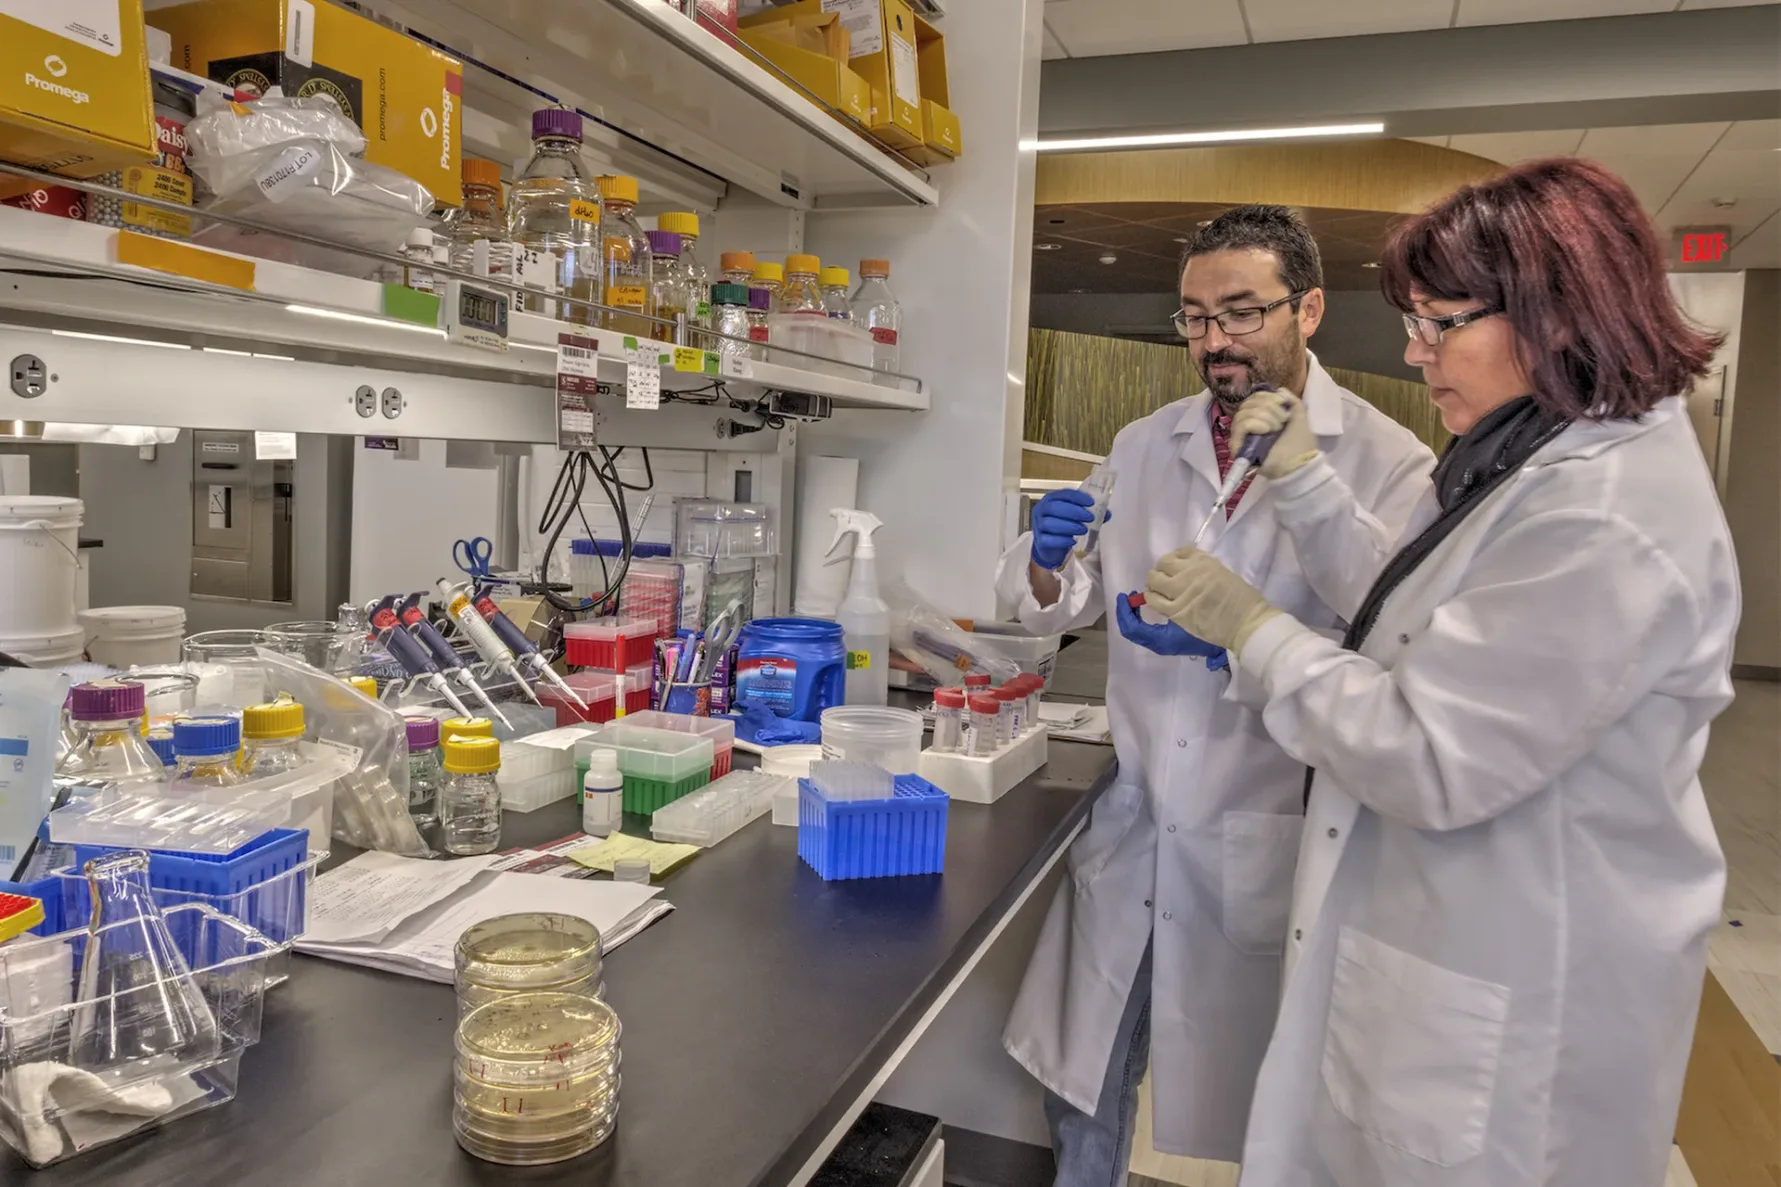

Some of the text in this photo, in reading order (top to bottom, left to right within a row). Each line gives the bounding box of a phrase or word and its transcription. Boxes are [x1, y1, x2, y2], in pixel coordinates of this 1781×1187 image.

[25, 72, 90, 104] Promega
[379, 67, 388, 141] promega.com
[440, 87, 453, 171] Promega
[294, 151, 313, 170] LOT
[1682, 232, 1725, 262] EXIT
